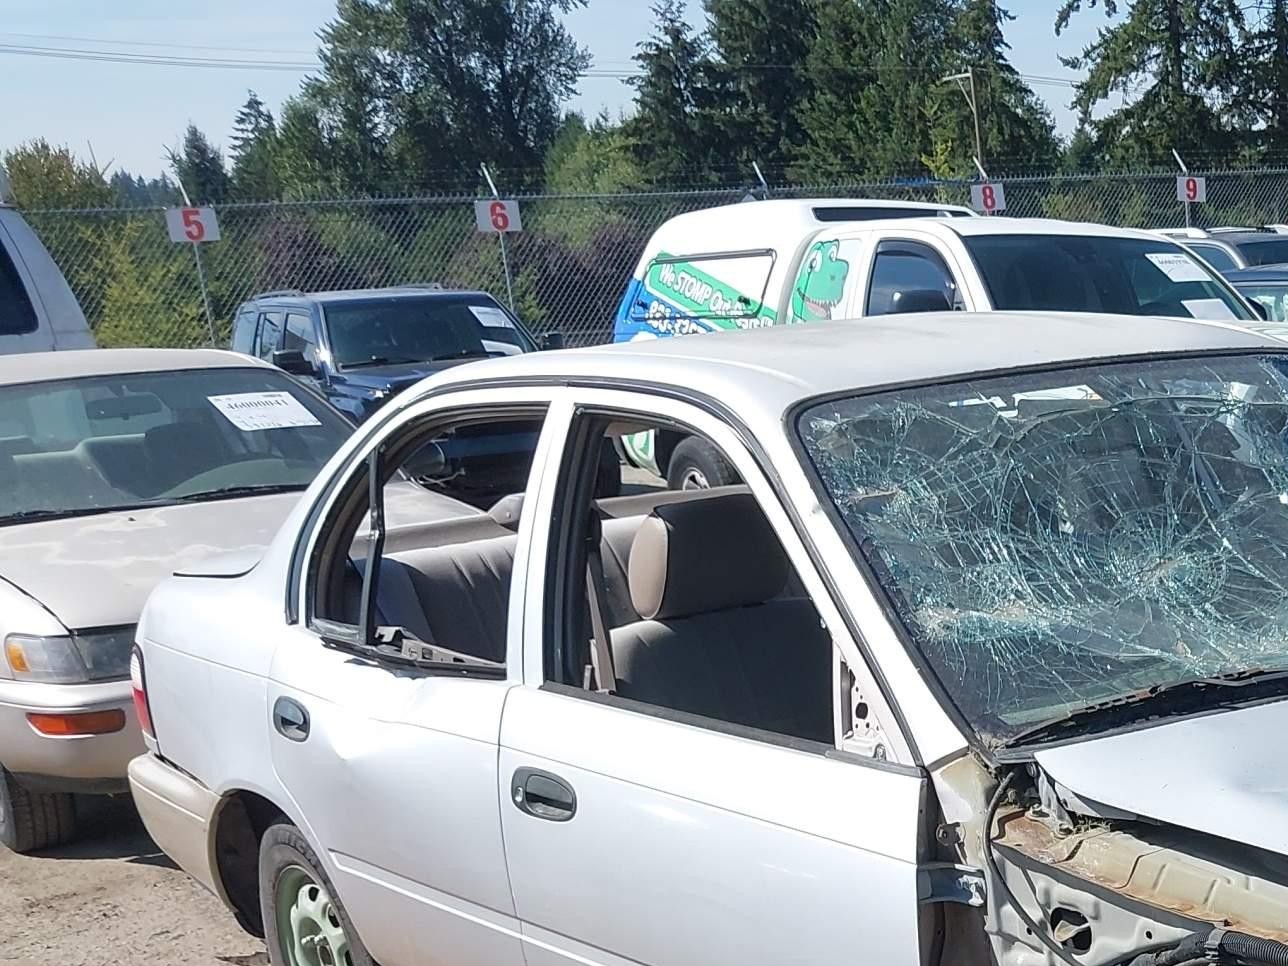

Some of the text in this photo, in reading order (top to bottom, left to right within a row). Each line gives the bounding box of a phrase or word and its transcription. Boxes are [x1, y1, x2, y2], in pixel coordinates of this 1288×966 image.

[982, 186, 996, 209] 8
[1186, 178, 1197, 201] 9
[182, 210, 205, 240] 5
[491, 202, 509, 230] 6
[658, 263, 676, 288] We
[673, 270, 713, 305] STOMP
